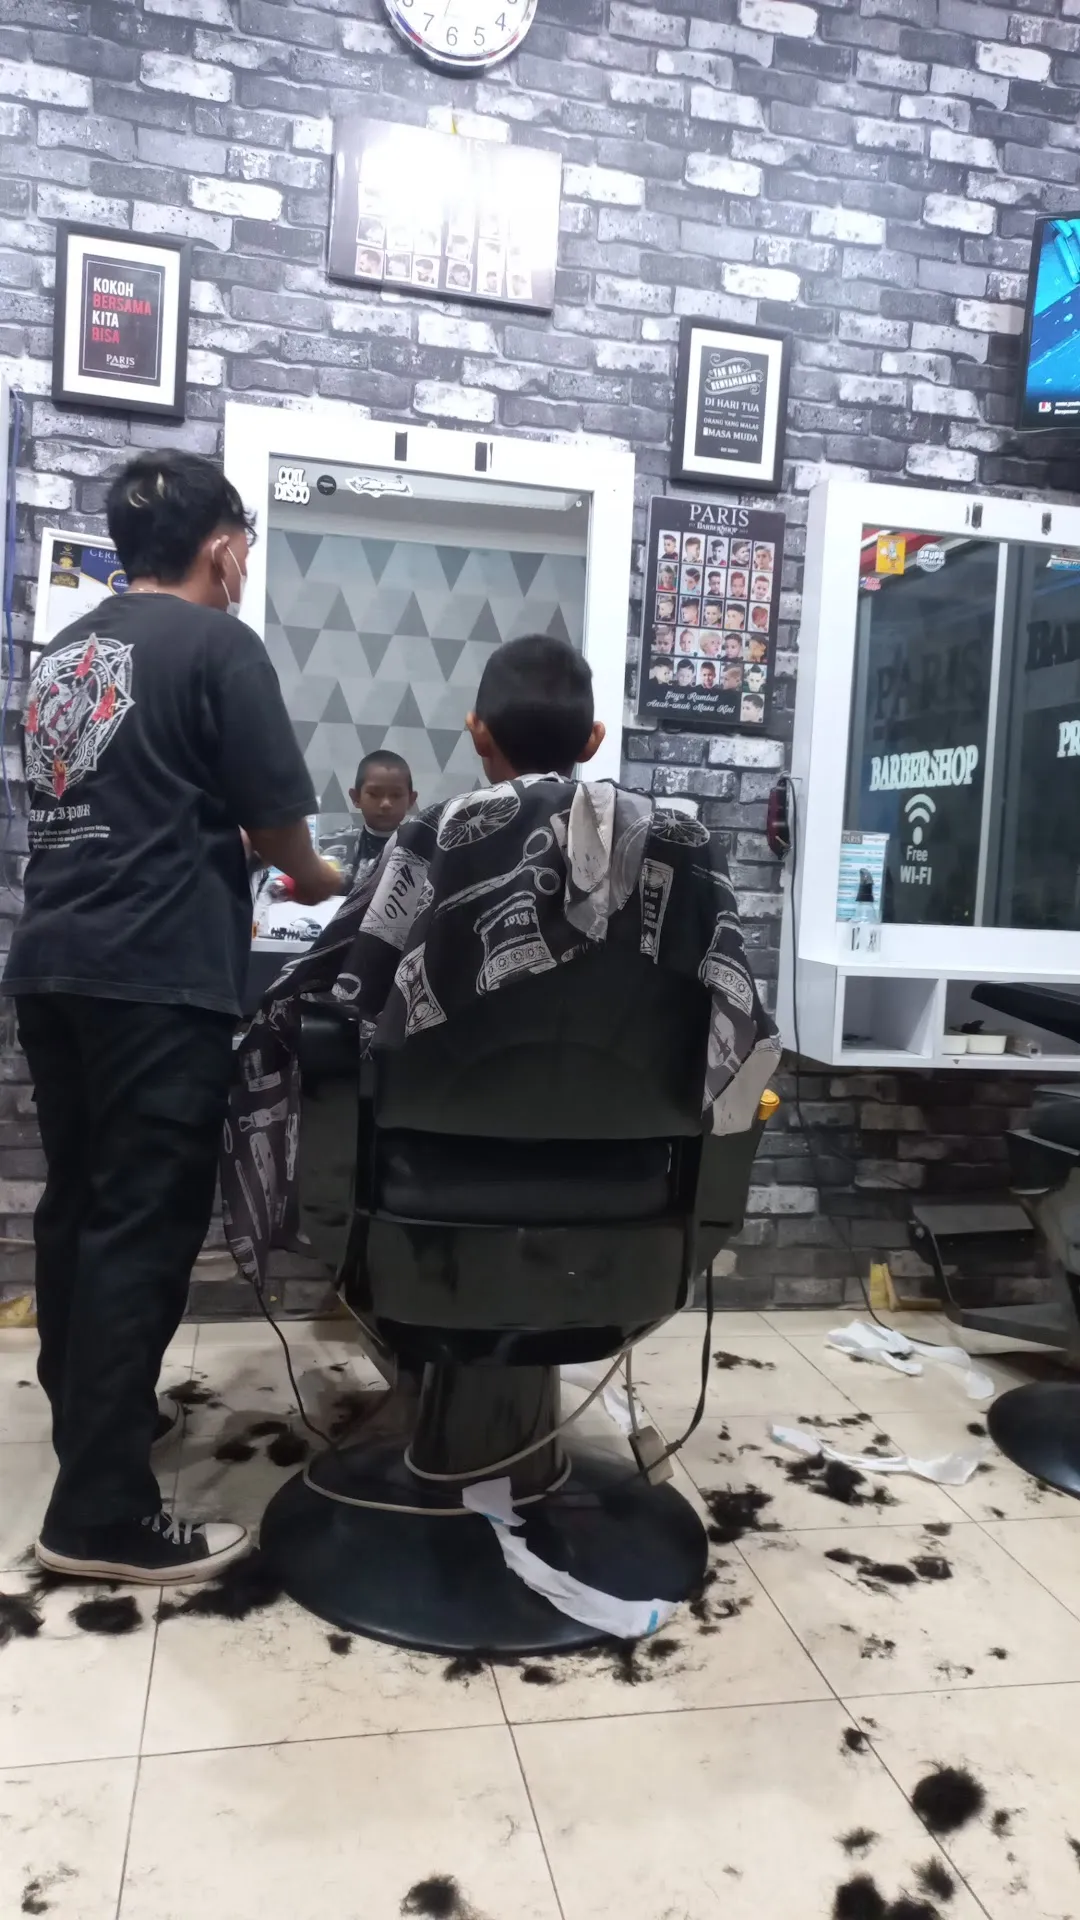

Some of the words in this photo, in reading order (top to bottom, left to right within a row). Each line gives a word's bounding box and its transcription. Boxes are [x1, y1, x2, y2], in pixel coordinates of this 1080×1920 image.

[423, 12, 434, 32] 7
[495, 12, 506, 31] 4
[446, 26, 459, 46] 6
[473, 26, 486, 46] 5
[93, 277, 134, 297] KOKOH
[92, 294, 153, 316] BERSAMA
[92, 311, 120, 328] KITA
[91, 328, 120, 344] BISA
[106, 354, 136, 366] PARIS
[705, 397, 715, 407] DI
[717, 398, 740, 410] HARI
[741, 401, 760, 413] TUA
[703, 417, 724, 426] ORANG
[724, 420, 740, 428] YANG
[740, 422, 760, 431] MALAS
[708, 428, 732, 439] MASA
[733, 431, 759, 442] MUDA
[274, 482, 311, 505] DISCO
[689, 503, 750, 528] PARIS
[664, 690, 686, 702] Gaya
[686, 691, 720, 703] Rambut
[692, 702, 715, 713] Masa
[716, 704, 736, 715] Kini
[869, 744, 979, 791] BARBERSHOP
[906, 845, 929, 862] Free
